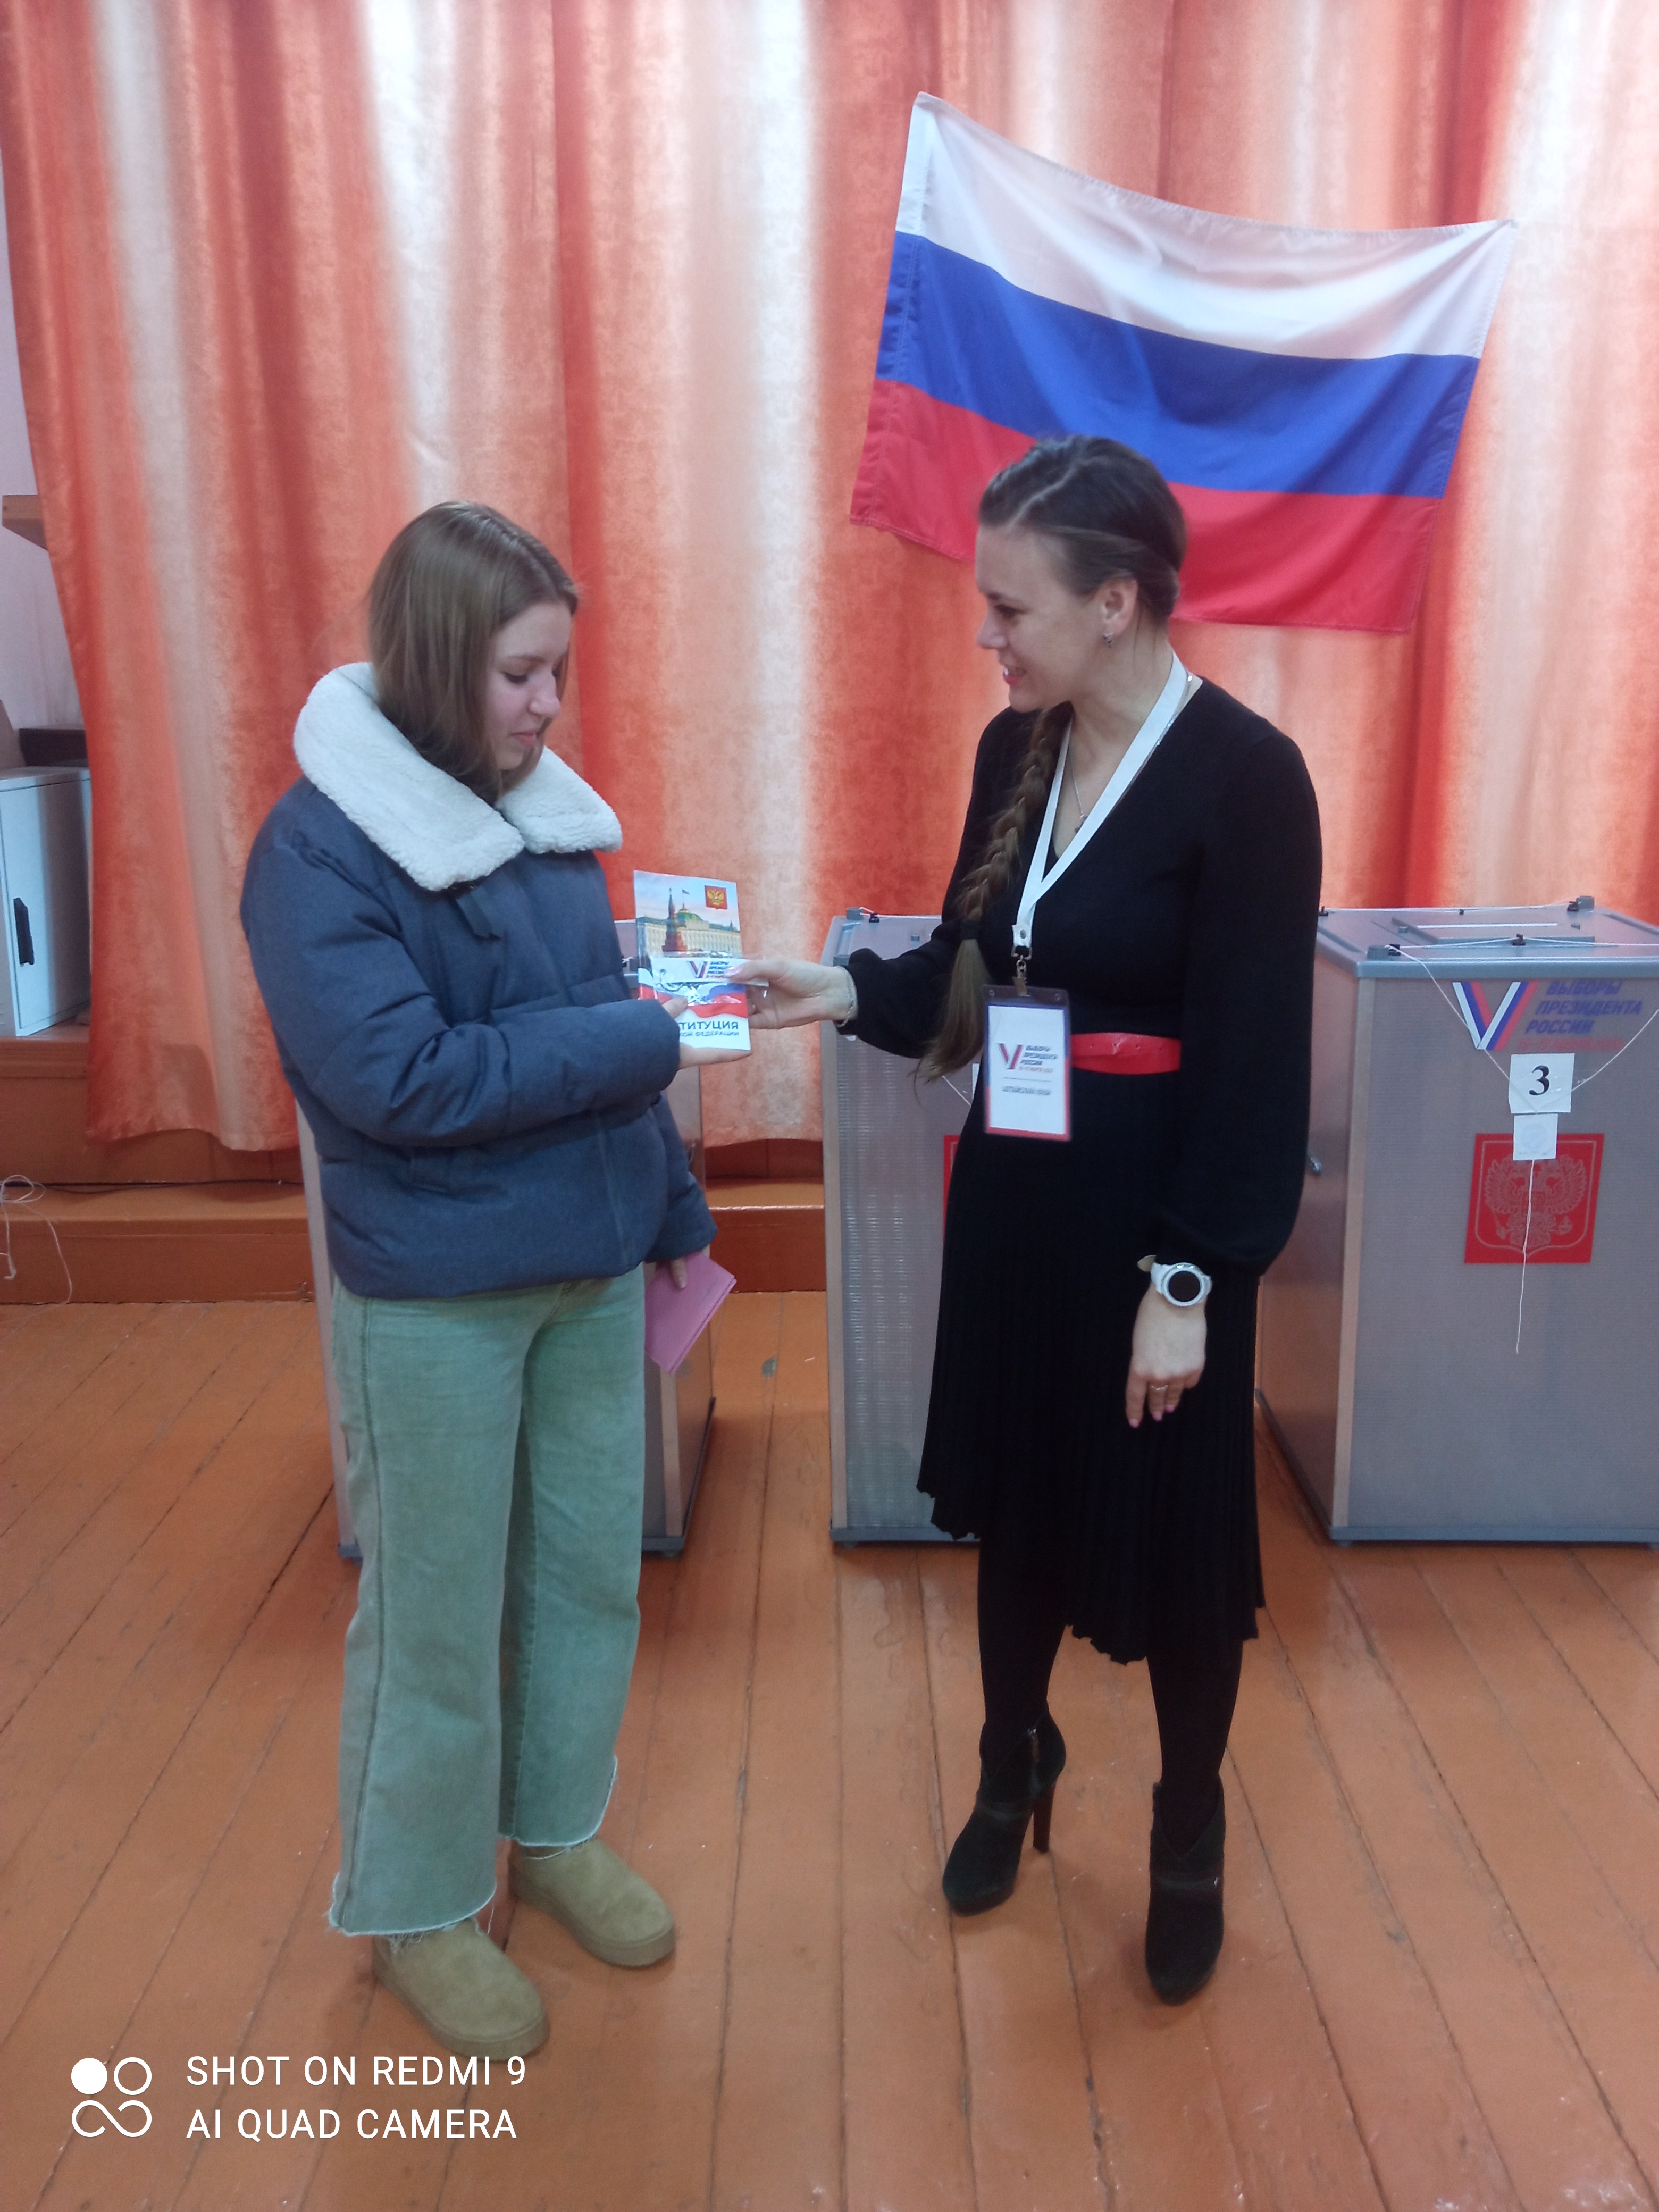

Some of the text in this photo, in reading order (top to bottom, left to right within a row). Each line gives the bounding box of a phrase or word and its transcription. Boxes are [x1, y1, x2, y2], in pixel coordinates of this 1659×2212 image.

[1546, 981, 1624, 995] ВЫБОРЫ
[1535, 1000, 1644, 1017] ПРЕЗИДЕНТА
[679, 1021, 738, 1030] ТИТУЦИЯ
[1525, 1019, 1594, 1034] РОССИИ
[1529, 1065, 1550, 1096] 3
